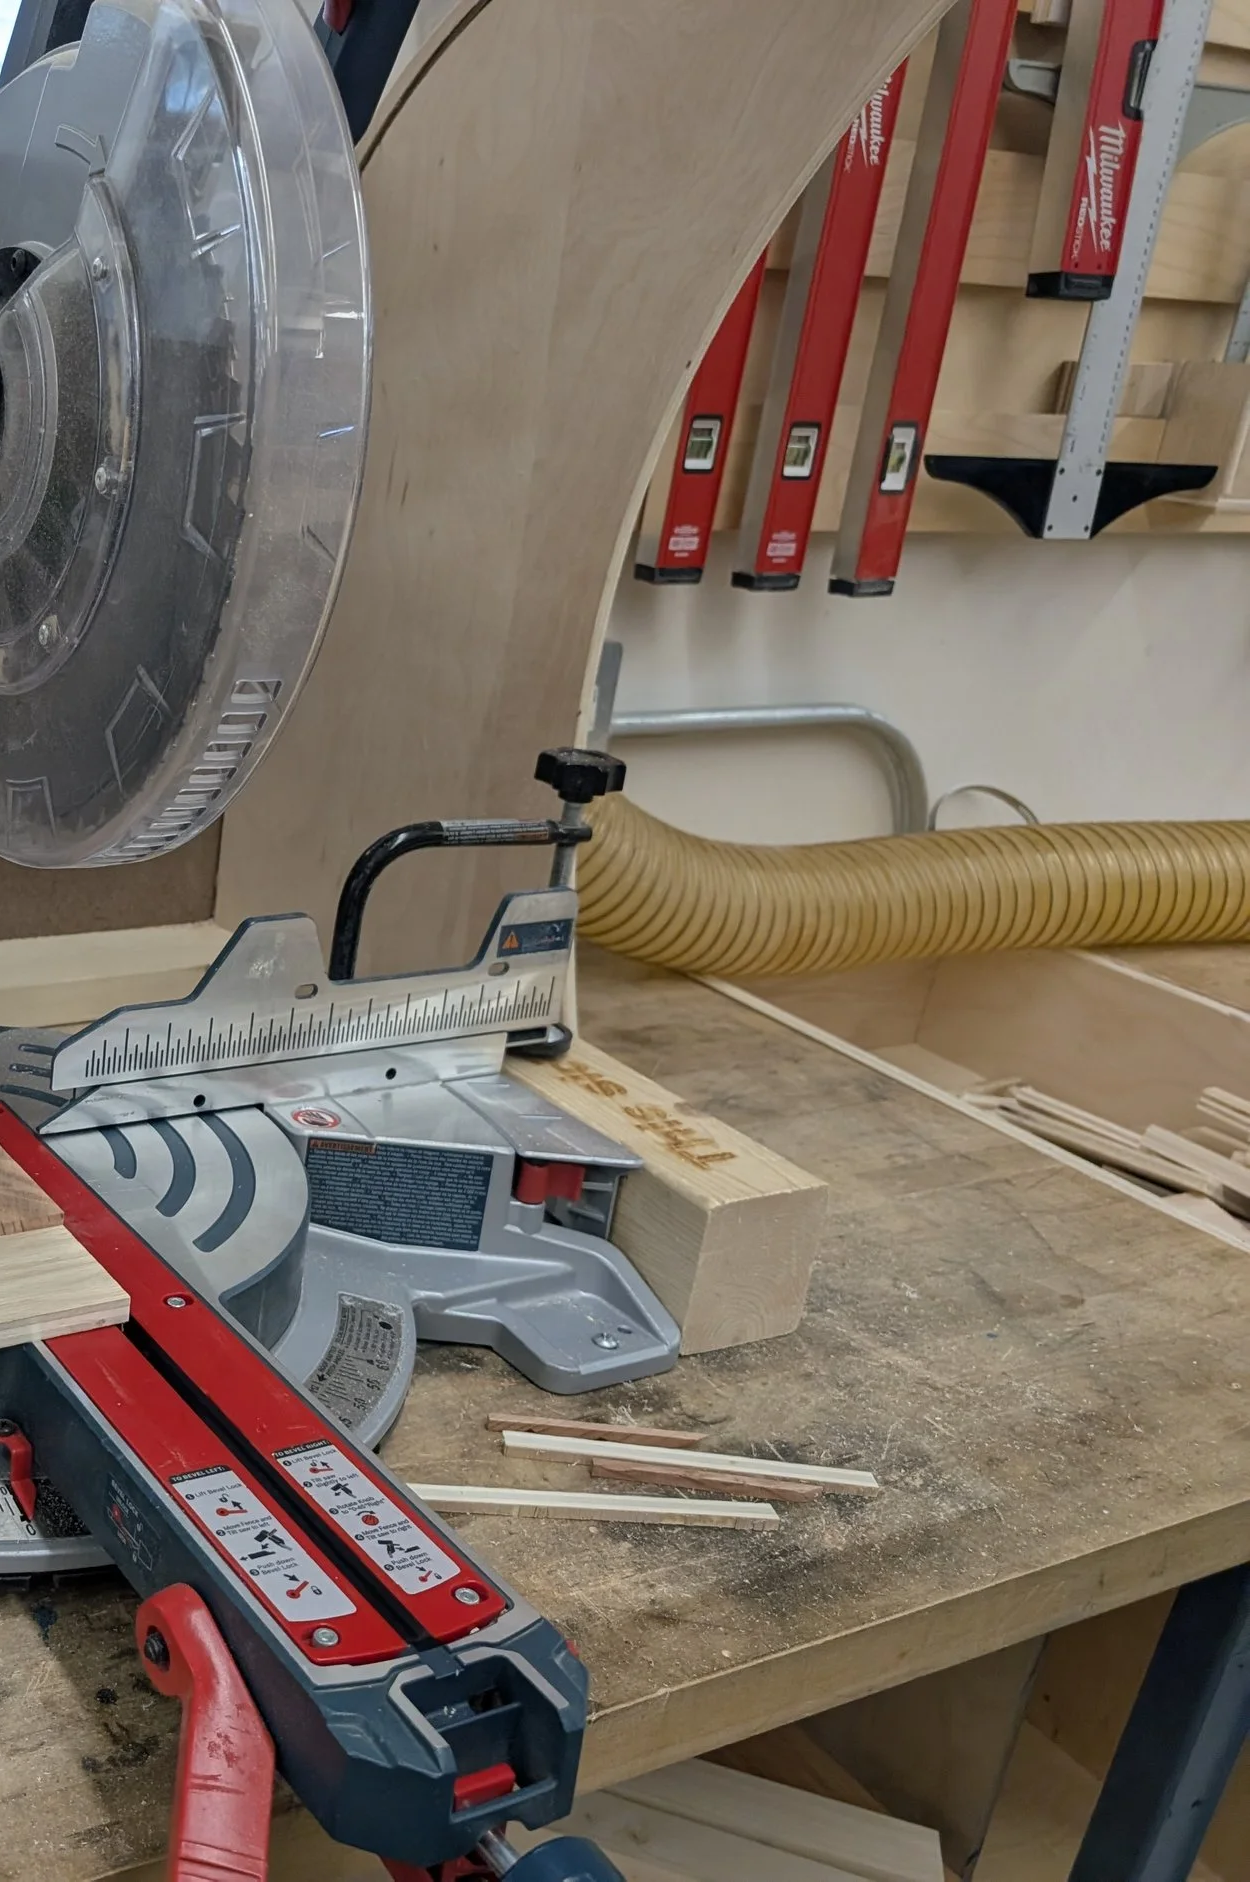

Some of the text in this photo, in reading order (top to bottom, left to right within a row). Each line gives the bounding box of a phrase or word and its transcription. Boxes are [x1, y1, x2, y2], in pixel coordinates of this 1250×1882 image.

[869, 76, 892, 166] lwaukee
[1098, 119, 1126, 253] Milwaukee
[1071, 196, 1089, 260] REDSTICK
[353, 1398, 368, 1411] 50
[366, 1378, 382, 1391] 55
[284, 1445, 307, 1455] BEVEL
[291, 1456, 303, 1464] Lift
[303, 1452, 321, 1461] Bevel
[321, 1447, 337, 1456] Lock
[182, 1470, 206, 1479] BEVEL
[194, 1490, 207, 1498] Lift
[207, 1486, 226, 1495] Bevel
[226, 1482, 243, 1490] Lock
[25, 1522, 38, 1536] 0
[222, 1522, 241, 1531] Move
[240, 1517, 260, 1527] Fence
[258, 1521, 270, 1529] left
[361, 1527, 379, 1536] Move
[378, 1522, 398, 1531] Fence
[397, 1518, 410, 1526] and
[397, 1524, 412, 1532] right
[257, 1560, 276, 1570] Push
[275, 1557, 296, 1565] down
[390, 1556, 409, 1565] Push
[409, 1552, 429, 1560] down
[396, 1557, 433, 1571] Bevel Lock
[261, 1562, 299, 1576] Bevel Lock
